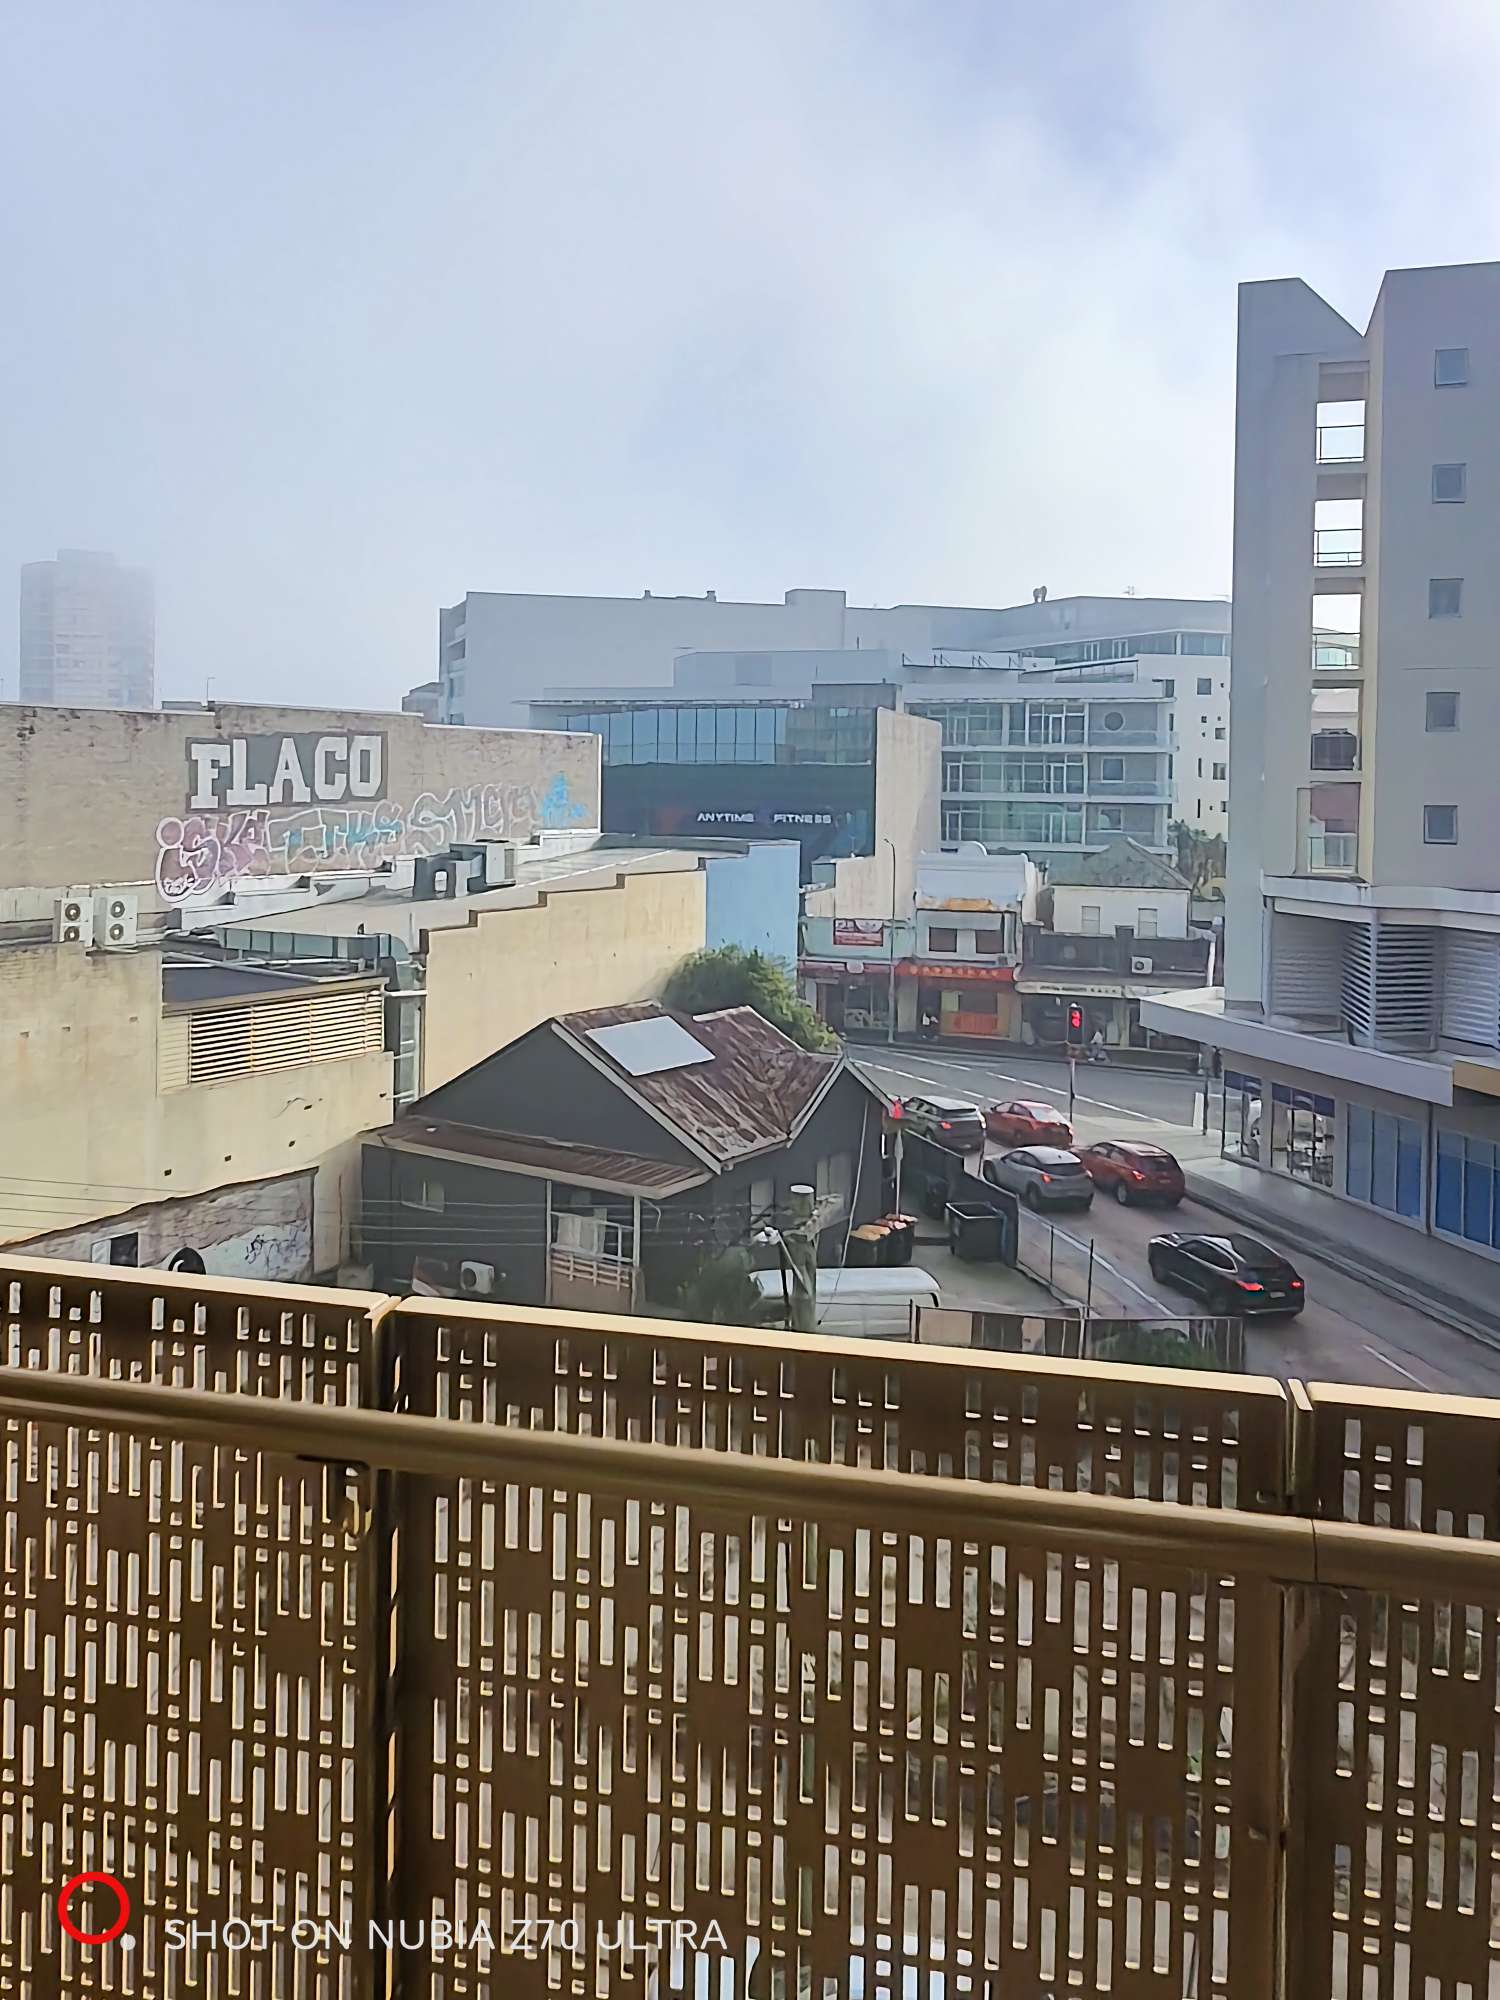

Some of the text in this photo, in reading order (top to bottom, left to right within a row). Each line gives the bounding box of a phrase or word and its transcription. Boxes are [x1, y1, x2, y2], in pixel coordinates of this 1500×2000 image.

[190, 736, 382, 809] FLACO
[697, 812, 832, 824] ANYTIME FITNESS
